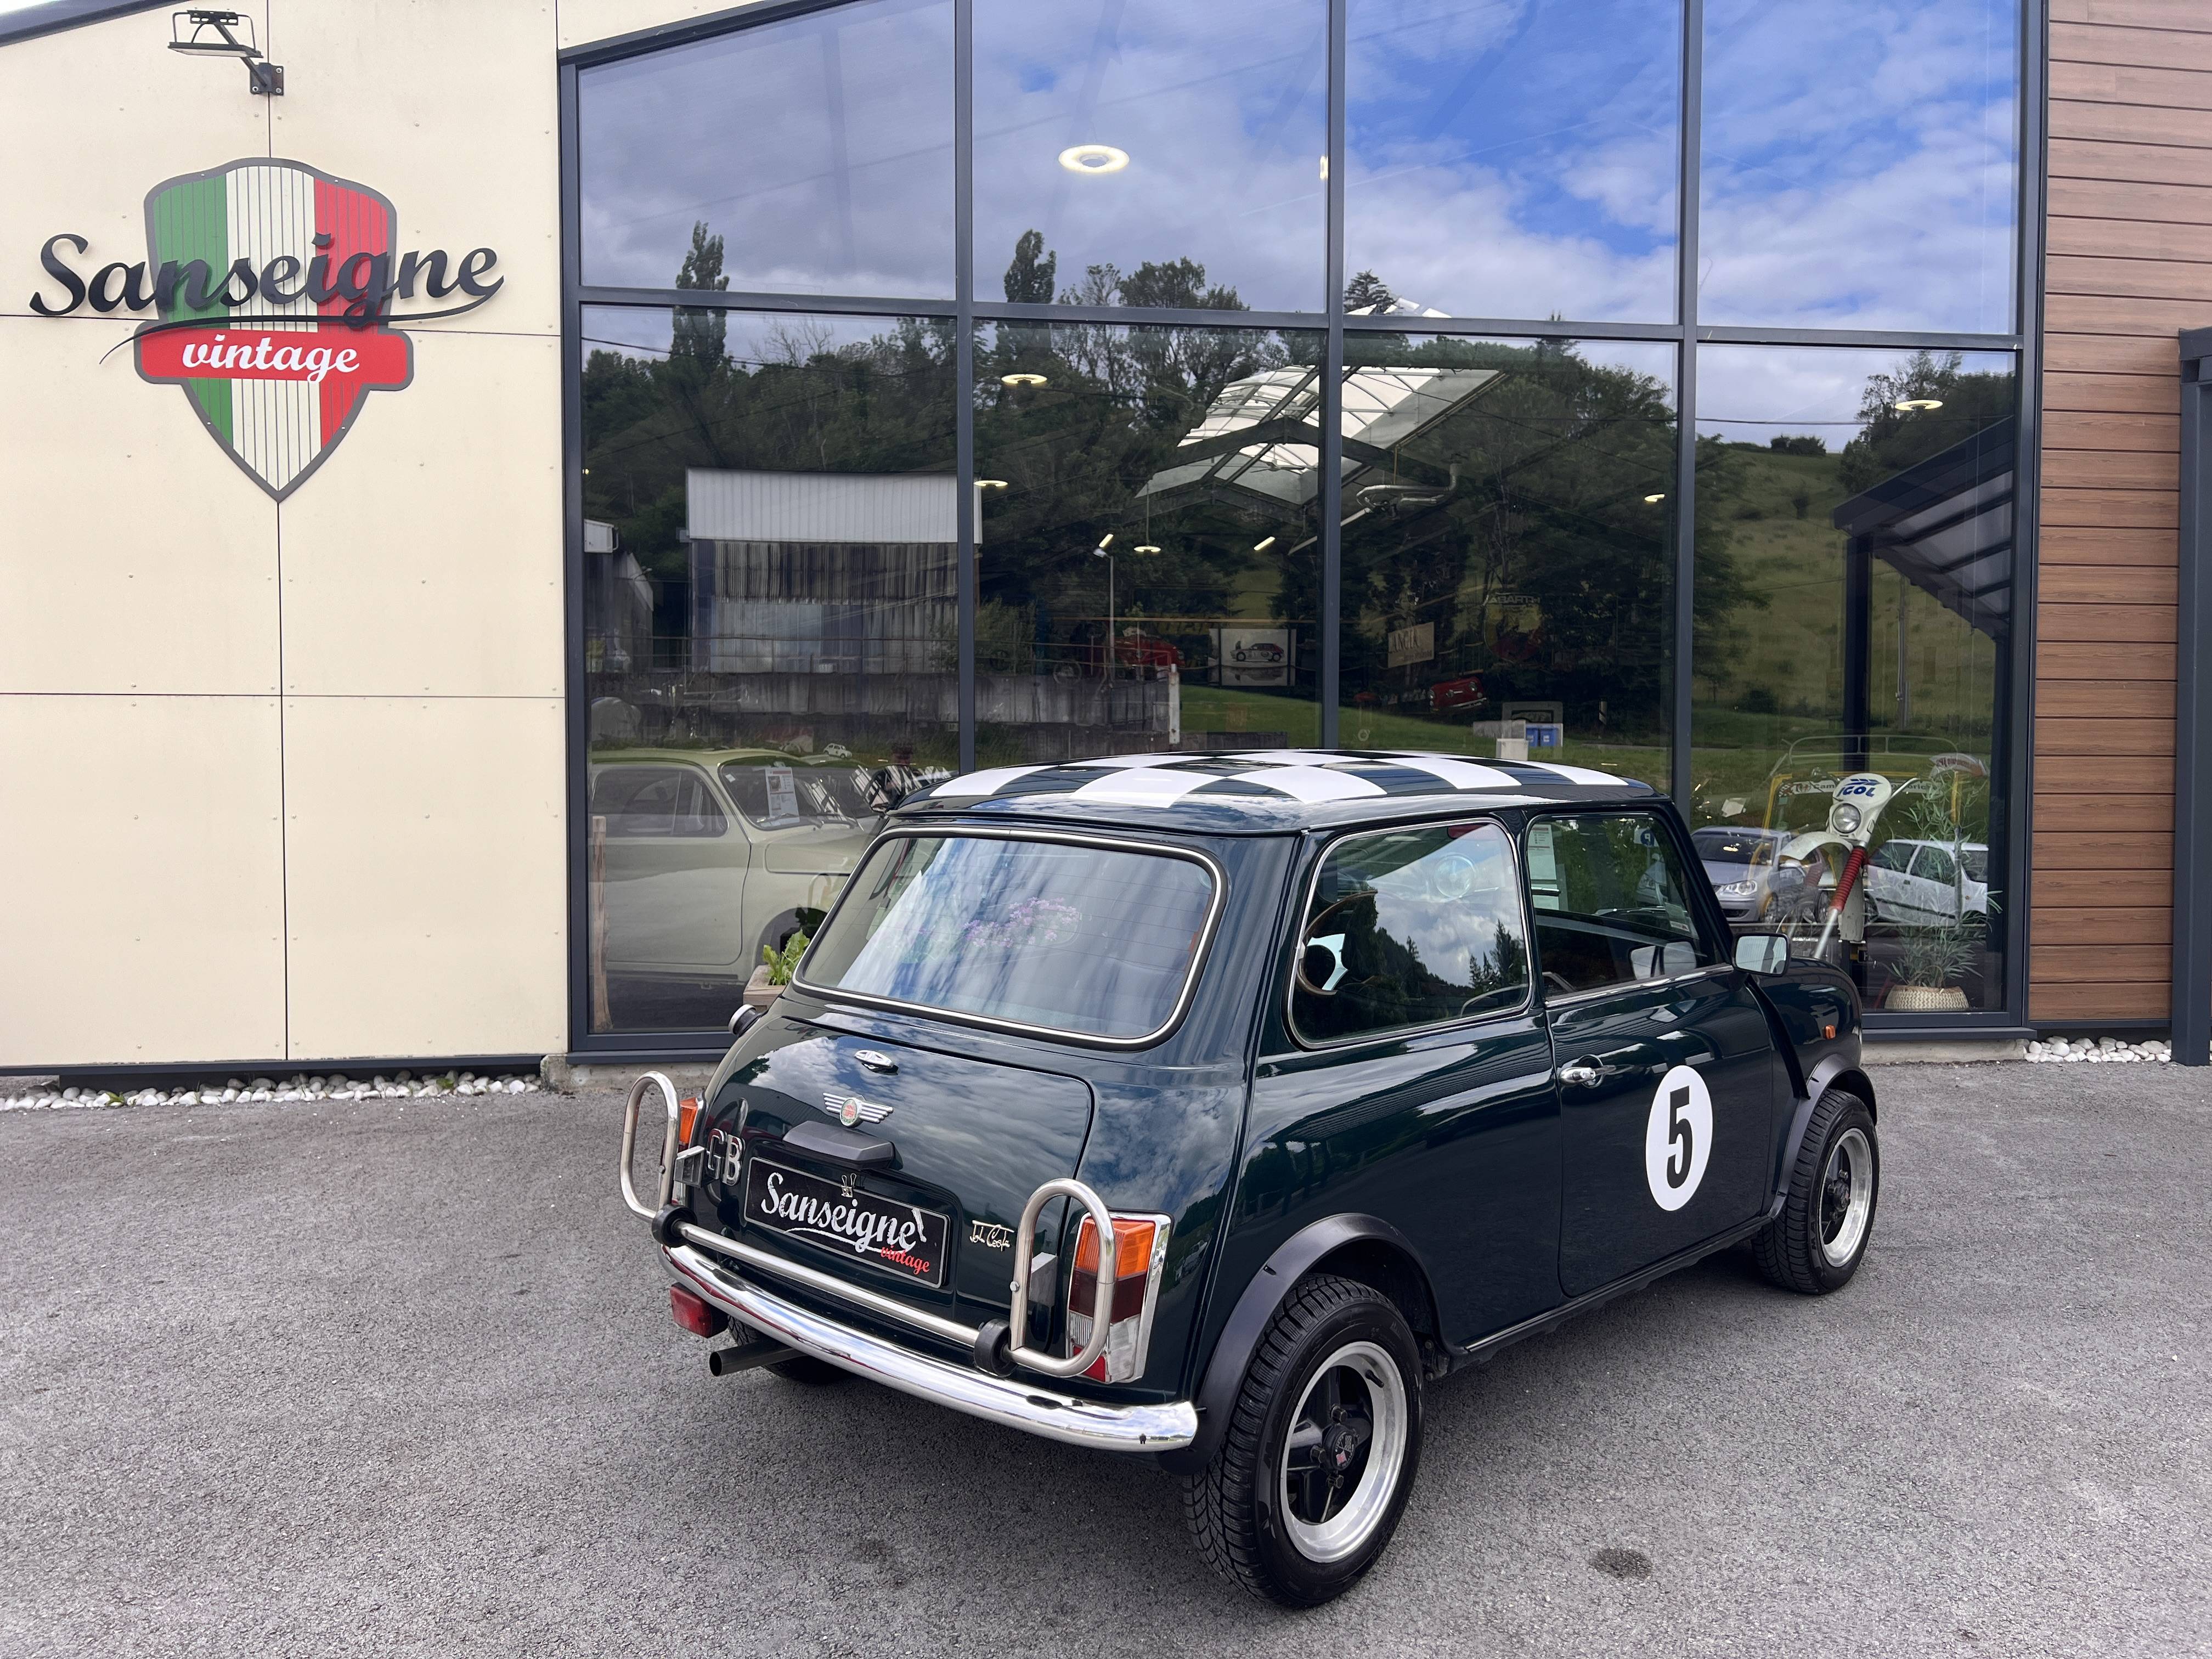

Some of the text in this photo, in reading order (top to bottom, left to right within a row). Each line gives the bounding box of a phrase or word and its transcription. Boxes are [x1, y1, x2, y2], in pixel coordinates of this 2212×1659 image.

[29, 233, 505, 329] Sanseigne
[182, 333, 360, 383] vintage
[1836, 786, 1875, 798] IGOL
[706, 1128, 742, 1186] GB
[1666, 1085, 1693, 1189] 5
[760, 1172, 917, 1253] Sanseigne
[880, 1245, 930, 1276] vintage
